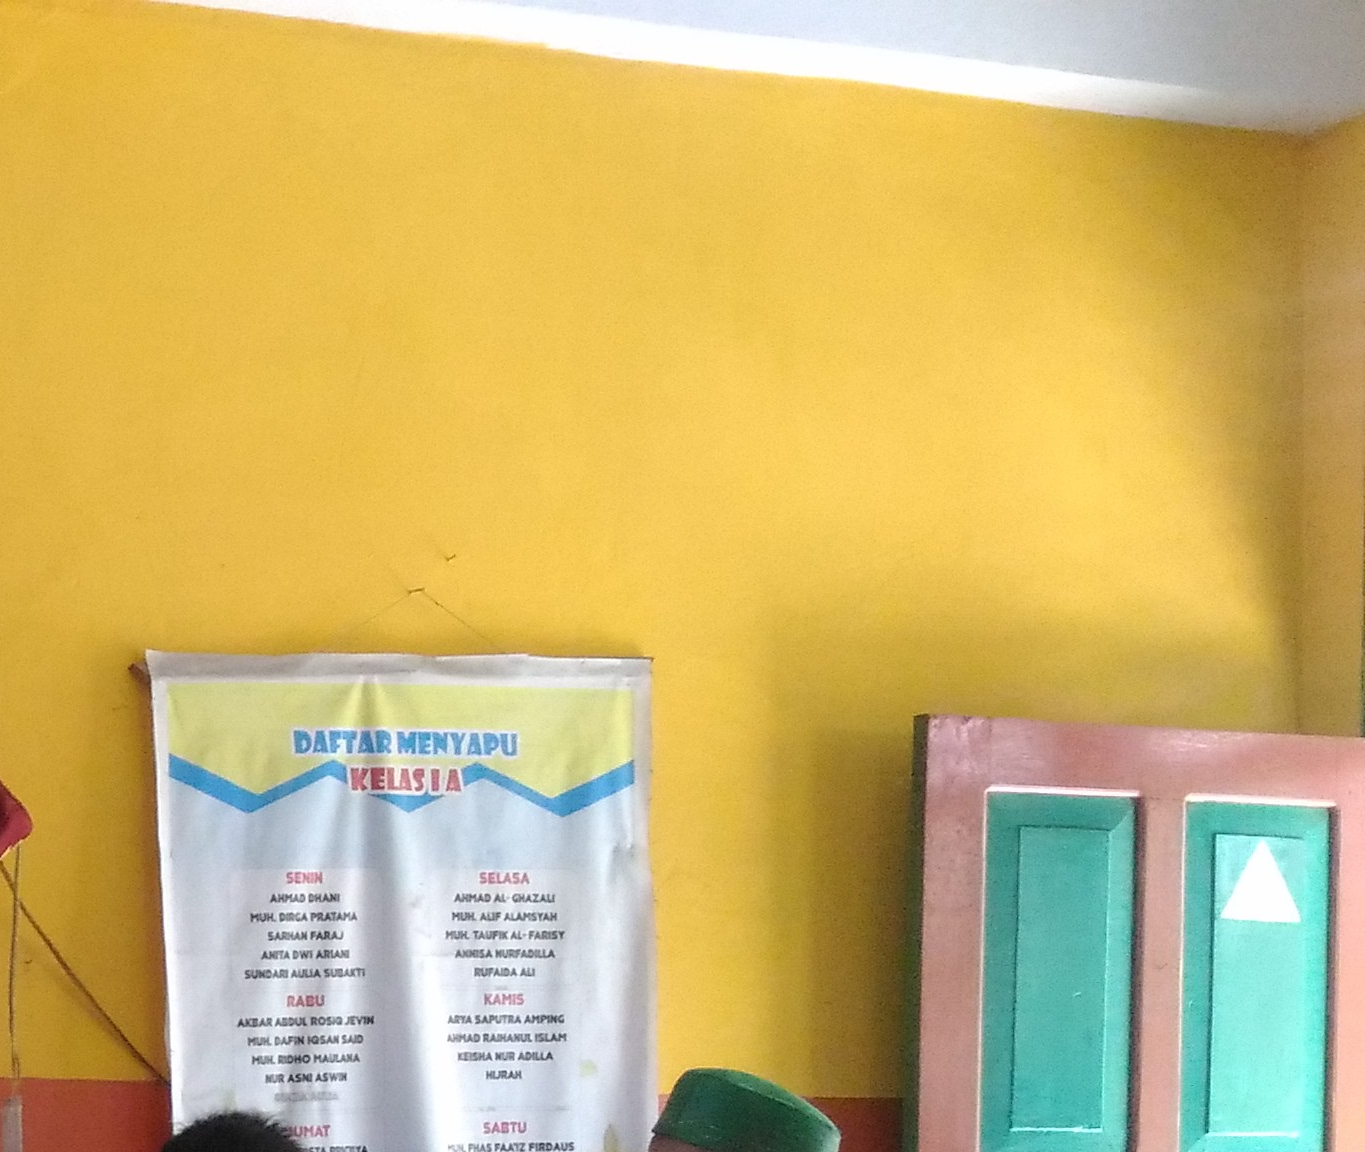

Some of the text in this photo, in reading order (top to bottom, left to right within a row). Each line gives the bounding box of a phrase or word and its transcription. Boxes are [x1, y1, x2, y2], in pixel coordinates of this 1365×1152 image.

[292, 728, 520, 759] DAFTAR MENYAPU
[349, 766, 426, 794] KELAS
[444, 767, 464, 792] A
[286, 871, 323, 884] SENIN
[479, 872, 530, 884] SELASA
[270, 893, 341, 903] AHMAD DHANI
[454, 893, 492, 903] AHMAD
[511, 893, 556, 903] GHAZALI
[310, 911, 358, 922] PRATAMA
[451, 912, 558, 922] MUH. ALIF ALAMSYAH
[310, 931, 344, 941] FARAJ
[445, 930, 470, 940] MUH.
[472, 930, 509, 940] TAUFIK
[528, 930, 566, 940] FARISY
[292, 950, 313, 960] DWI
[454, 949, 556, 959] ANNISA NURFADILLA
[244, 968, 366, 979] SUNDARI AULIA SUBAKTI
[474, 967, 536, 977] RUFAIDA ALI
[286, 995, 326, 1007] RABU
[483, 993, 525, 1006] KAMIS
[237, 1017, 273, 1028] AKBAR
[274, 1017, 308, 1027] ABDUL
[447, 1014, 565, 1024] ARYA SAPUTRA AMPING
[274, 1035, 305, 1046] DAFIN
[341, 1034, 364, 1044] SAID
[447, 1033, 567, 1043] AHMAD RAIHANUL ISLAM
[277, 1054, 311, 1064] RIDHO
[313, 1053, 361, 1063] MAULANA
[457, 1052, 554, 1062] KEISHA NUR ADILLA
[265, 1074, 285, 1084] NUR
[287, 1073, 313, 1083] ASNI
[483, 1121, 528, 1135] SABTU
[528, 1141, 575, 1152] FIRDAUS
